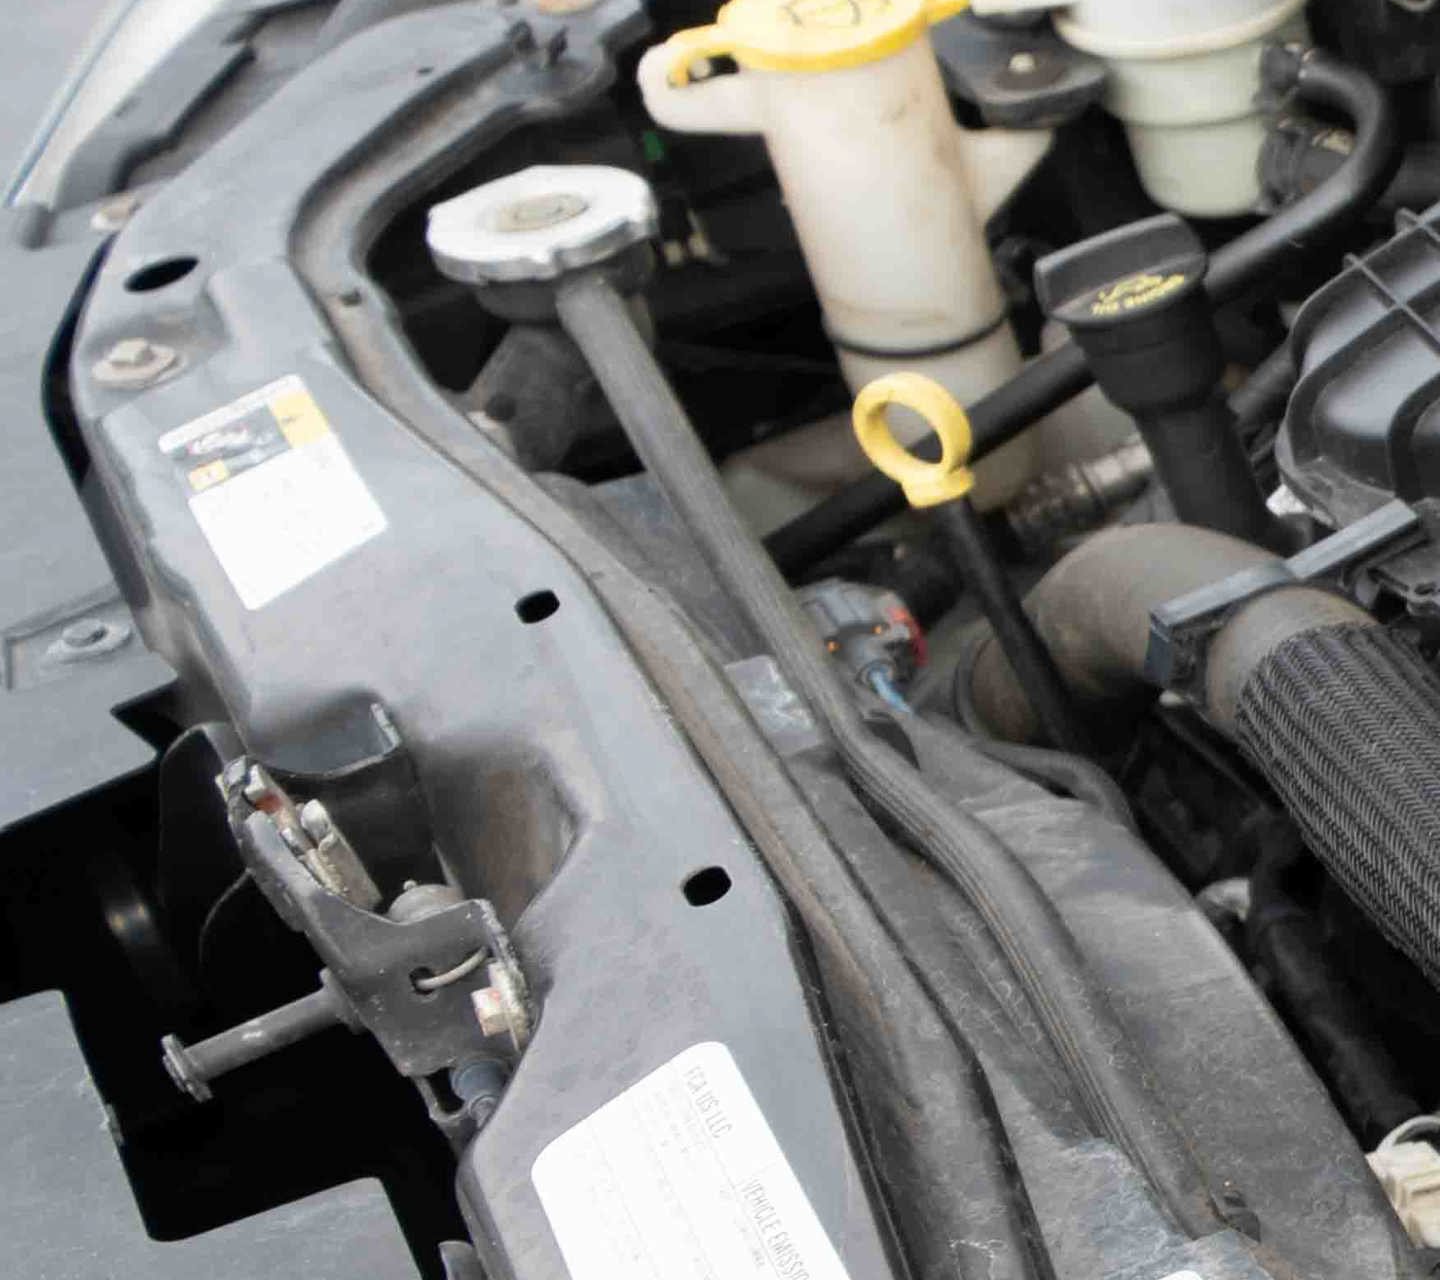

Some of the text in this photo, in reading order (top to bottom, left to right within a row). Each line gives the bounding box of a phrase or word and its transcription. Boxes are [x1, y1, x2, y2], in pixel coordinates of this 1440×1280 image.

[678, 1064, 735, 1141] FCA US LLC
[738, 1176, 783, 1235] VEHICLE
